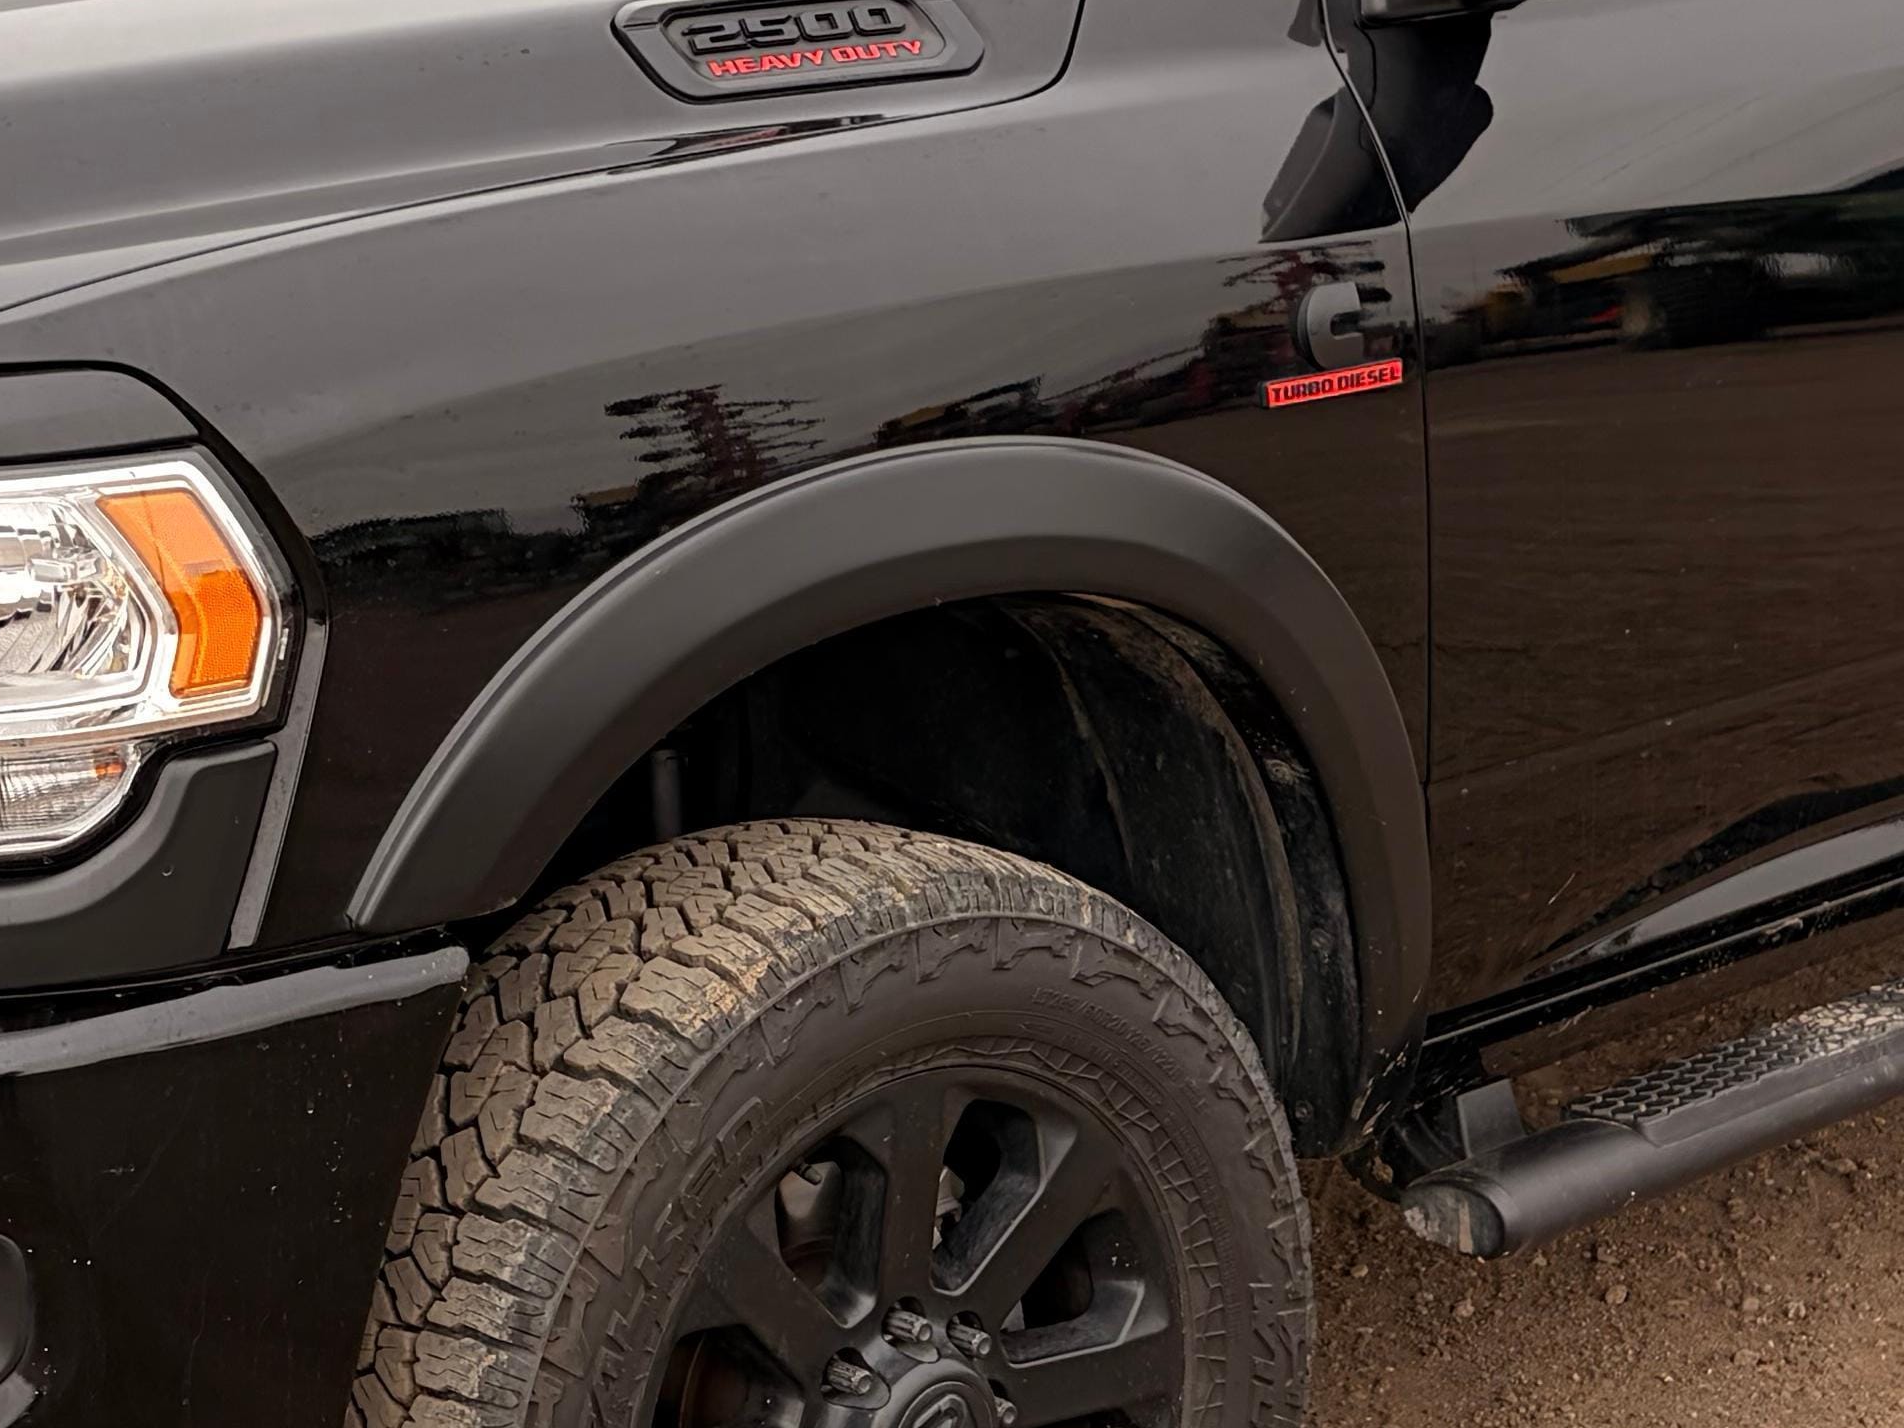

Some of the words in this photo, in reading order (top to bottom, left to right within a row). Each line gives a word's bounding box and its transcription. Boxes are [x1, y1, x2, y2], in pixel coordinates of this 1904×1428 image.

[684, 3, 906, 54] 2500
[708, 50, 826, 77] HEAVY
[831, 39, 924, 63] DUTY
[1270, 377, 1336, 403] TURBO
[1337, 365, 1402, 390] DIESEL
